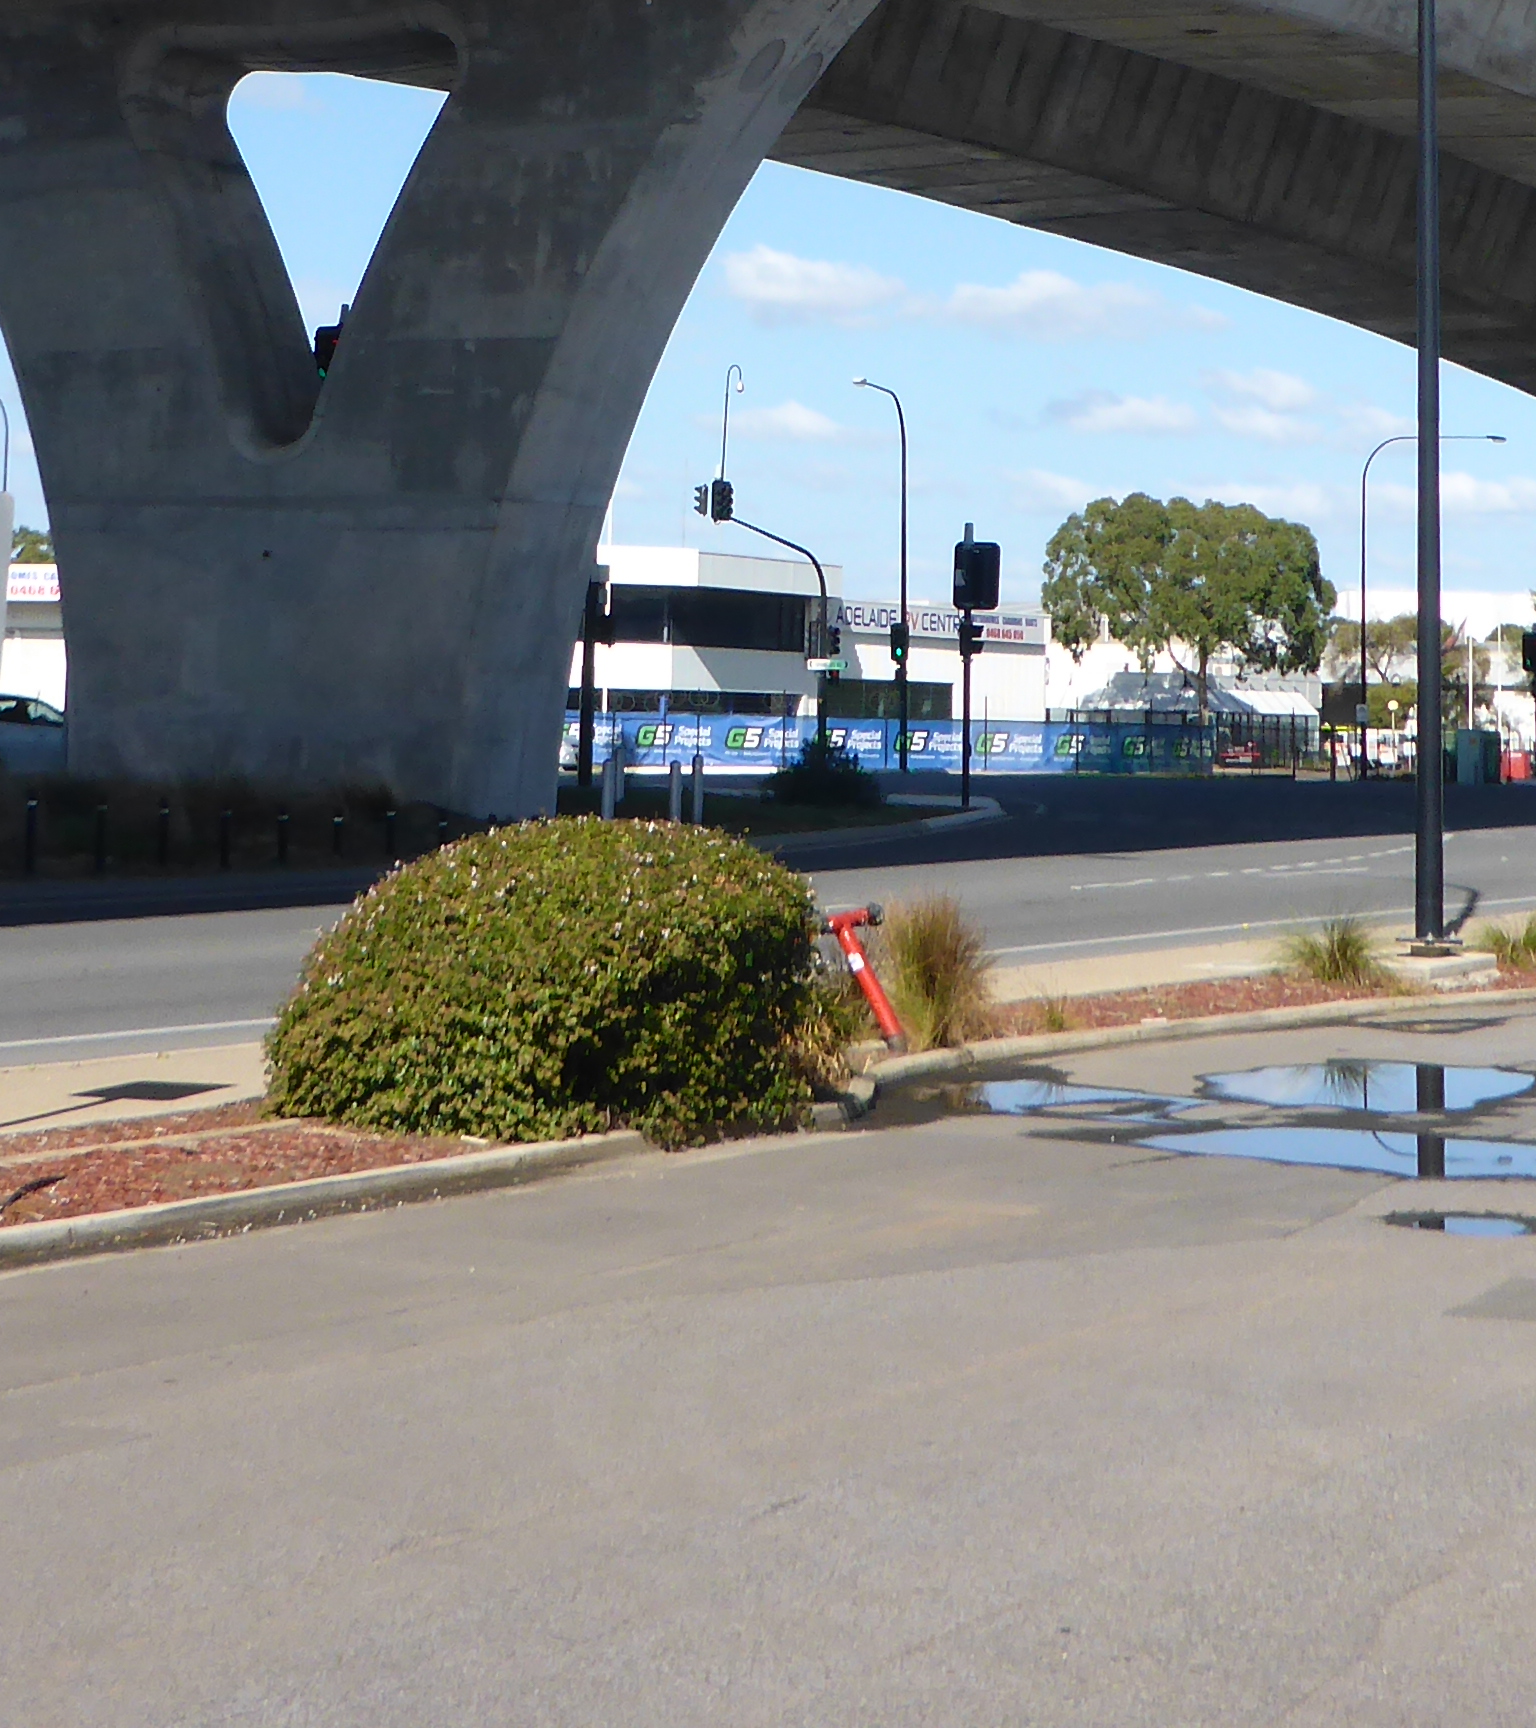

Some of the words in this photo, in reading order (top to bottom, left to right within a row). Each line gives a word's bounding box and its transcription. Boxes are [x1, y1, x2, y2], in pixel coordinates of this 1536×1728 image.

[836, 606, 897, 628] ADELAIDE
[922, 613, 960, 633] CENTR
[637, 725, 674, 746] G5
[678, 725, 712, 737] Special
[768, 728, 799, 740] Special
[850, 729, 882, 740] Special
[674, 735, 712, 747] Projects
[727, 728, 763, 749] G5
[896, 731, 928, 751] G5
[934, 732, 964, 743] Special
[976, 733, 1008, 753] G5
[1014, 734, 1043, 744] Special
[764, 738, 800, 750] Projects
[846, 739, 882, 751] Projects
[1008, 743, 1043, 754] Projects
[1056, 735, 1085, 755] G5
